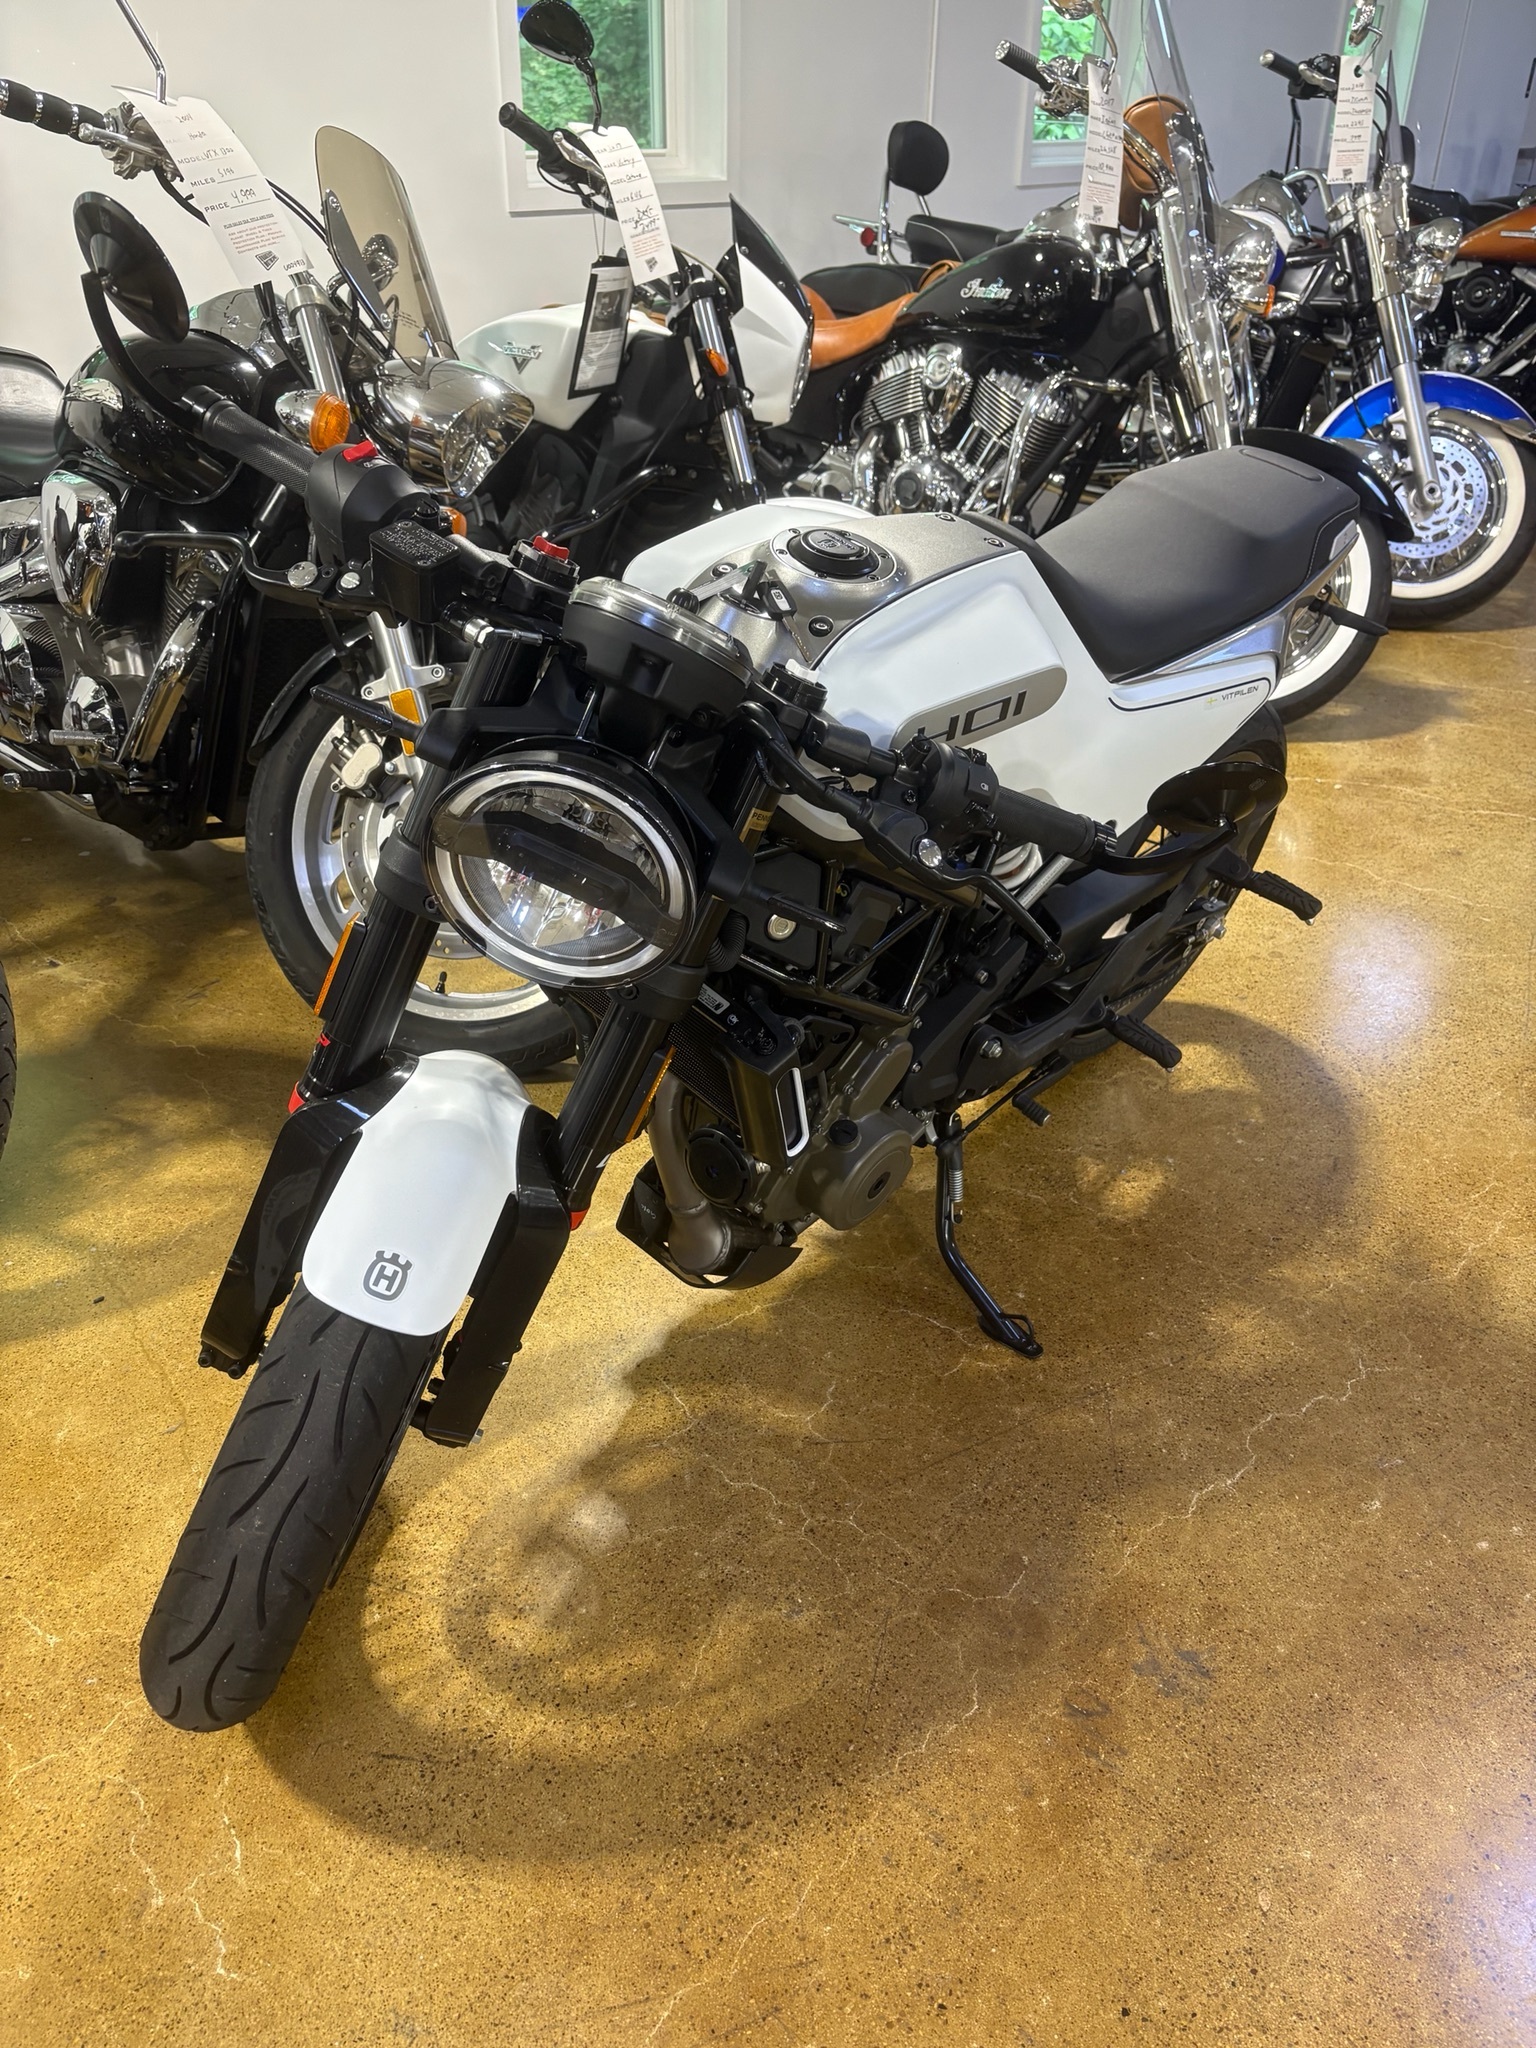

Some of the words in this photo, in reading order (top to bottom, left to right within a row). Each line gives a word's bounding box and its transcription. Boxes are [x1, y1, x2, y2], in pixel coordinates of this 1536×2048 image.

[177, 156, 206, 164] MODEL
[190, 177, 216, 188] MILES
[204, 201, 230, 213] PRICE
[503, 345, 538, 357] VICTORY
[1221, 685, 1259, 701] VITPILEN
